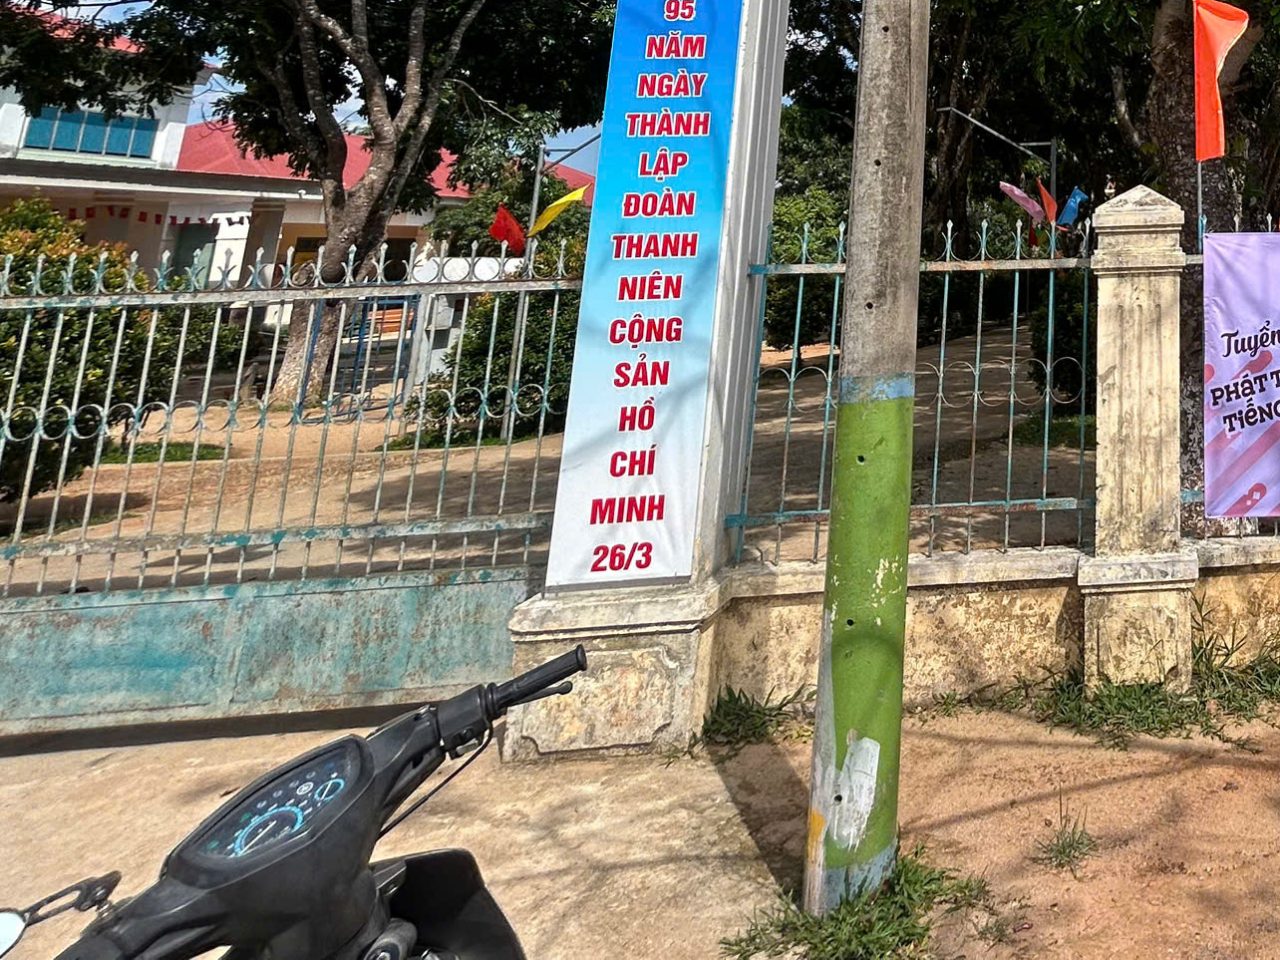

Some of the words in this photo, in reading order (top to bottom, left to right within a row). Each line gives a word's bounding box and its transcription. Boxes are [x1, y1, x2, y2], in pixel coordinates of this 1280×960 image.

[646, 31, 706, 59] NĂM
[637, 70, 707, 97] NGÀY
[626, 109, 711, 137] THÀNH
[639, 149, 688, 181] LẬP
[623, 189, 695, 217] ĐOÀN
[612, 233, 698, 259] THANH
[618, 272, 683, 301] NIÊN
[609, 313, 683, 349] CỘNG
[613, 353, 670, 388] SẢN
[618, 396, 656, 432] HỒ
[609, 444, 657, 478] CHÍ
[589, 494, 666, 525] MINH
[590, 542, 654, 573] 26/3
